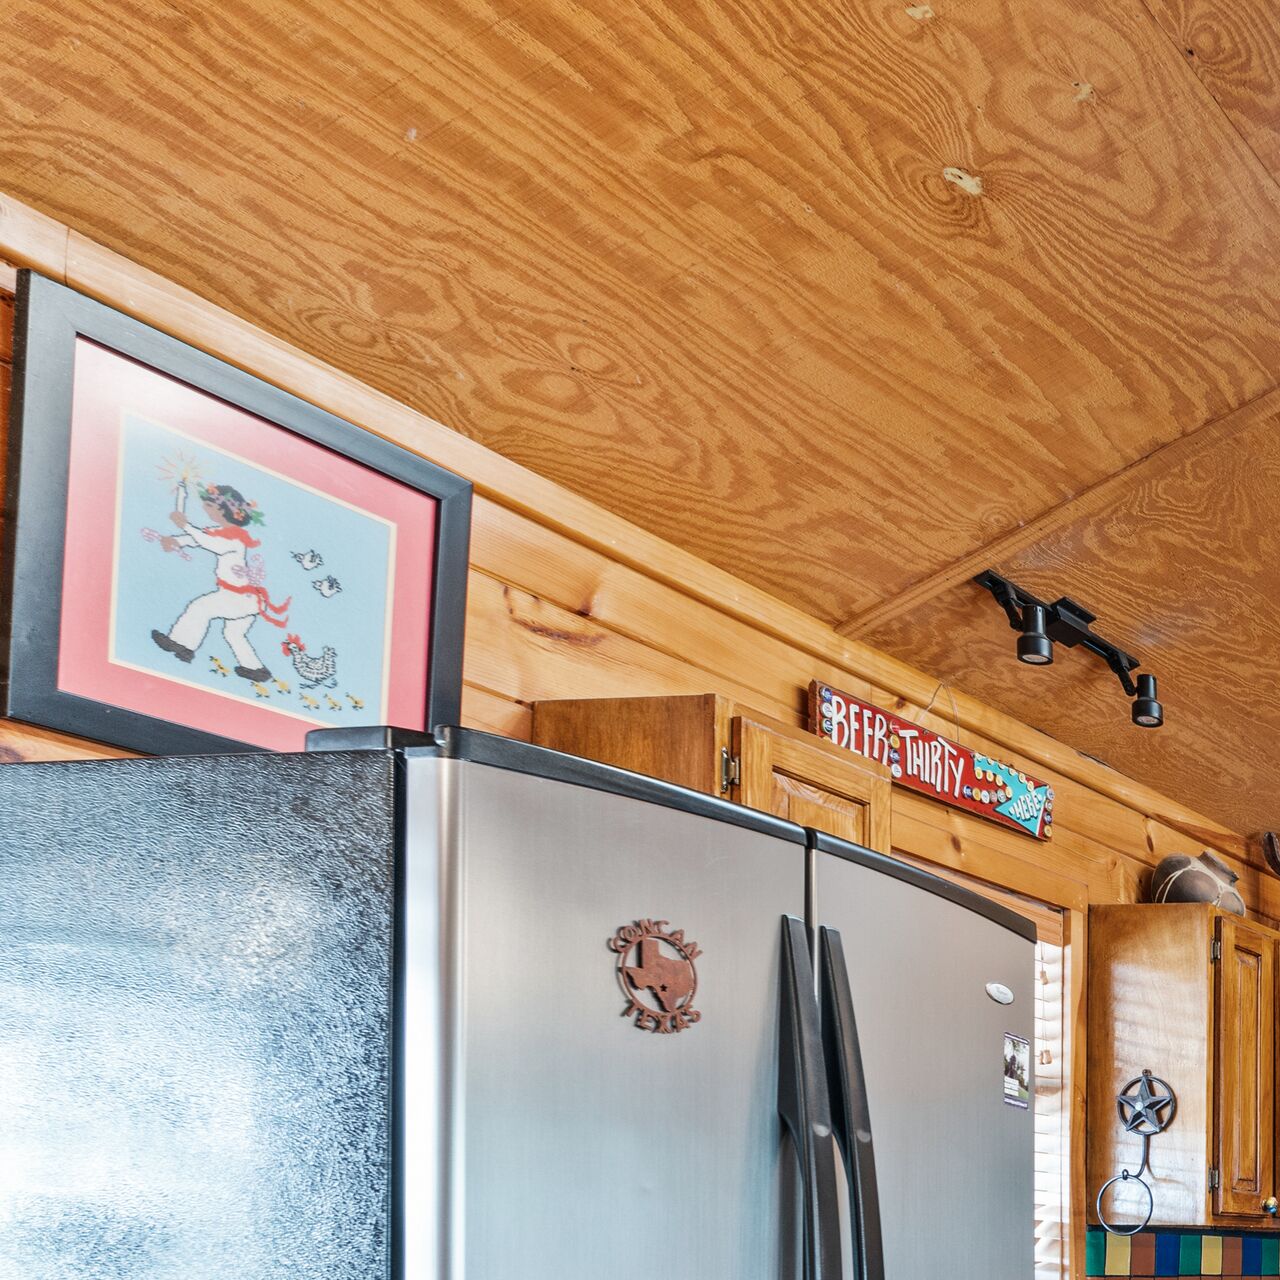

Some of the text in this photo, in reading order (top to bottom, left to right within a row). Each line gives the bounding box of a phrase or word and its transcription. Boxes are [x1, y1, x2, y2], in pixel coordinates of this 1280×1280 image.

[831, 695, 965, 799] BEER THIRTY
[610, 918, 703, 961] CONCAN
[621, 1000, 702, 1034] TEXAS
